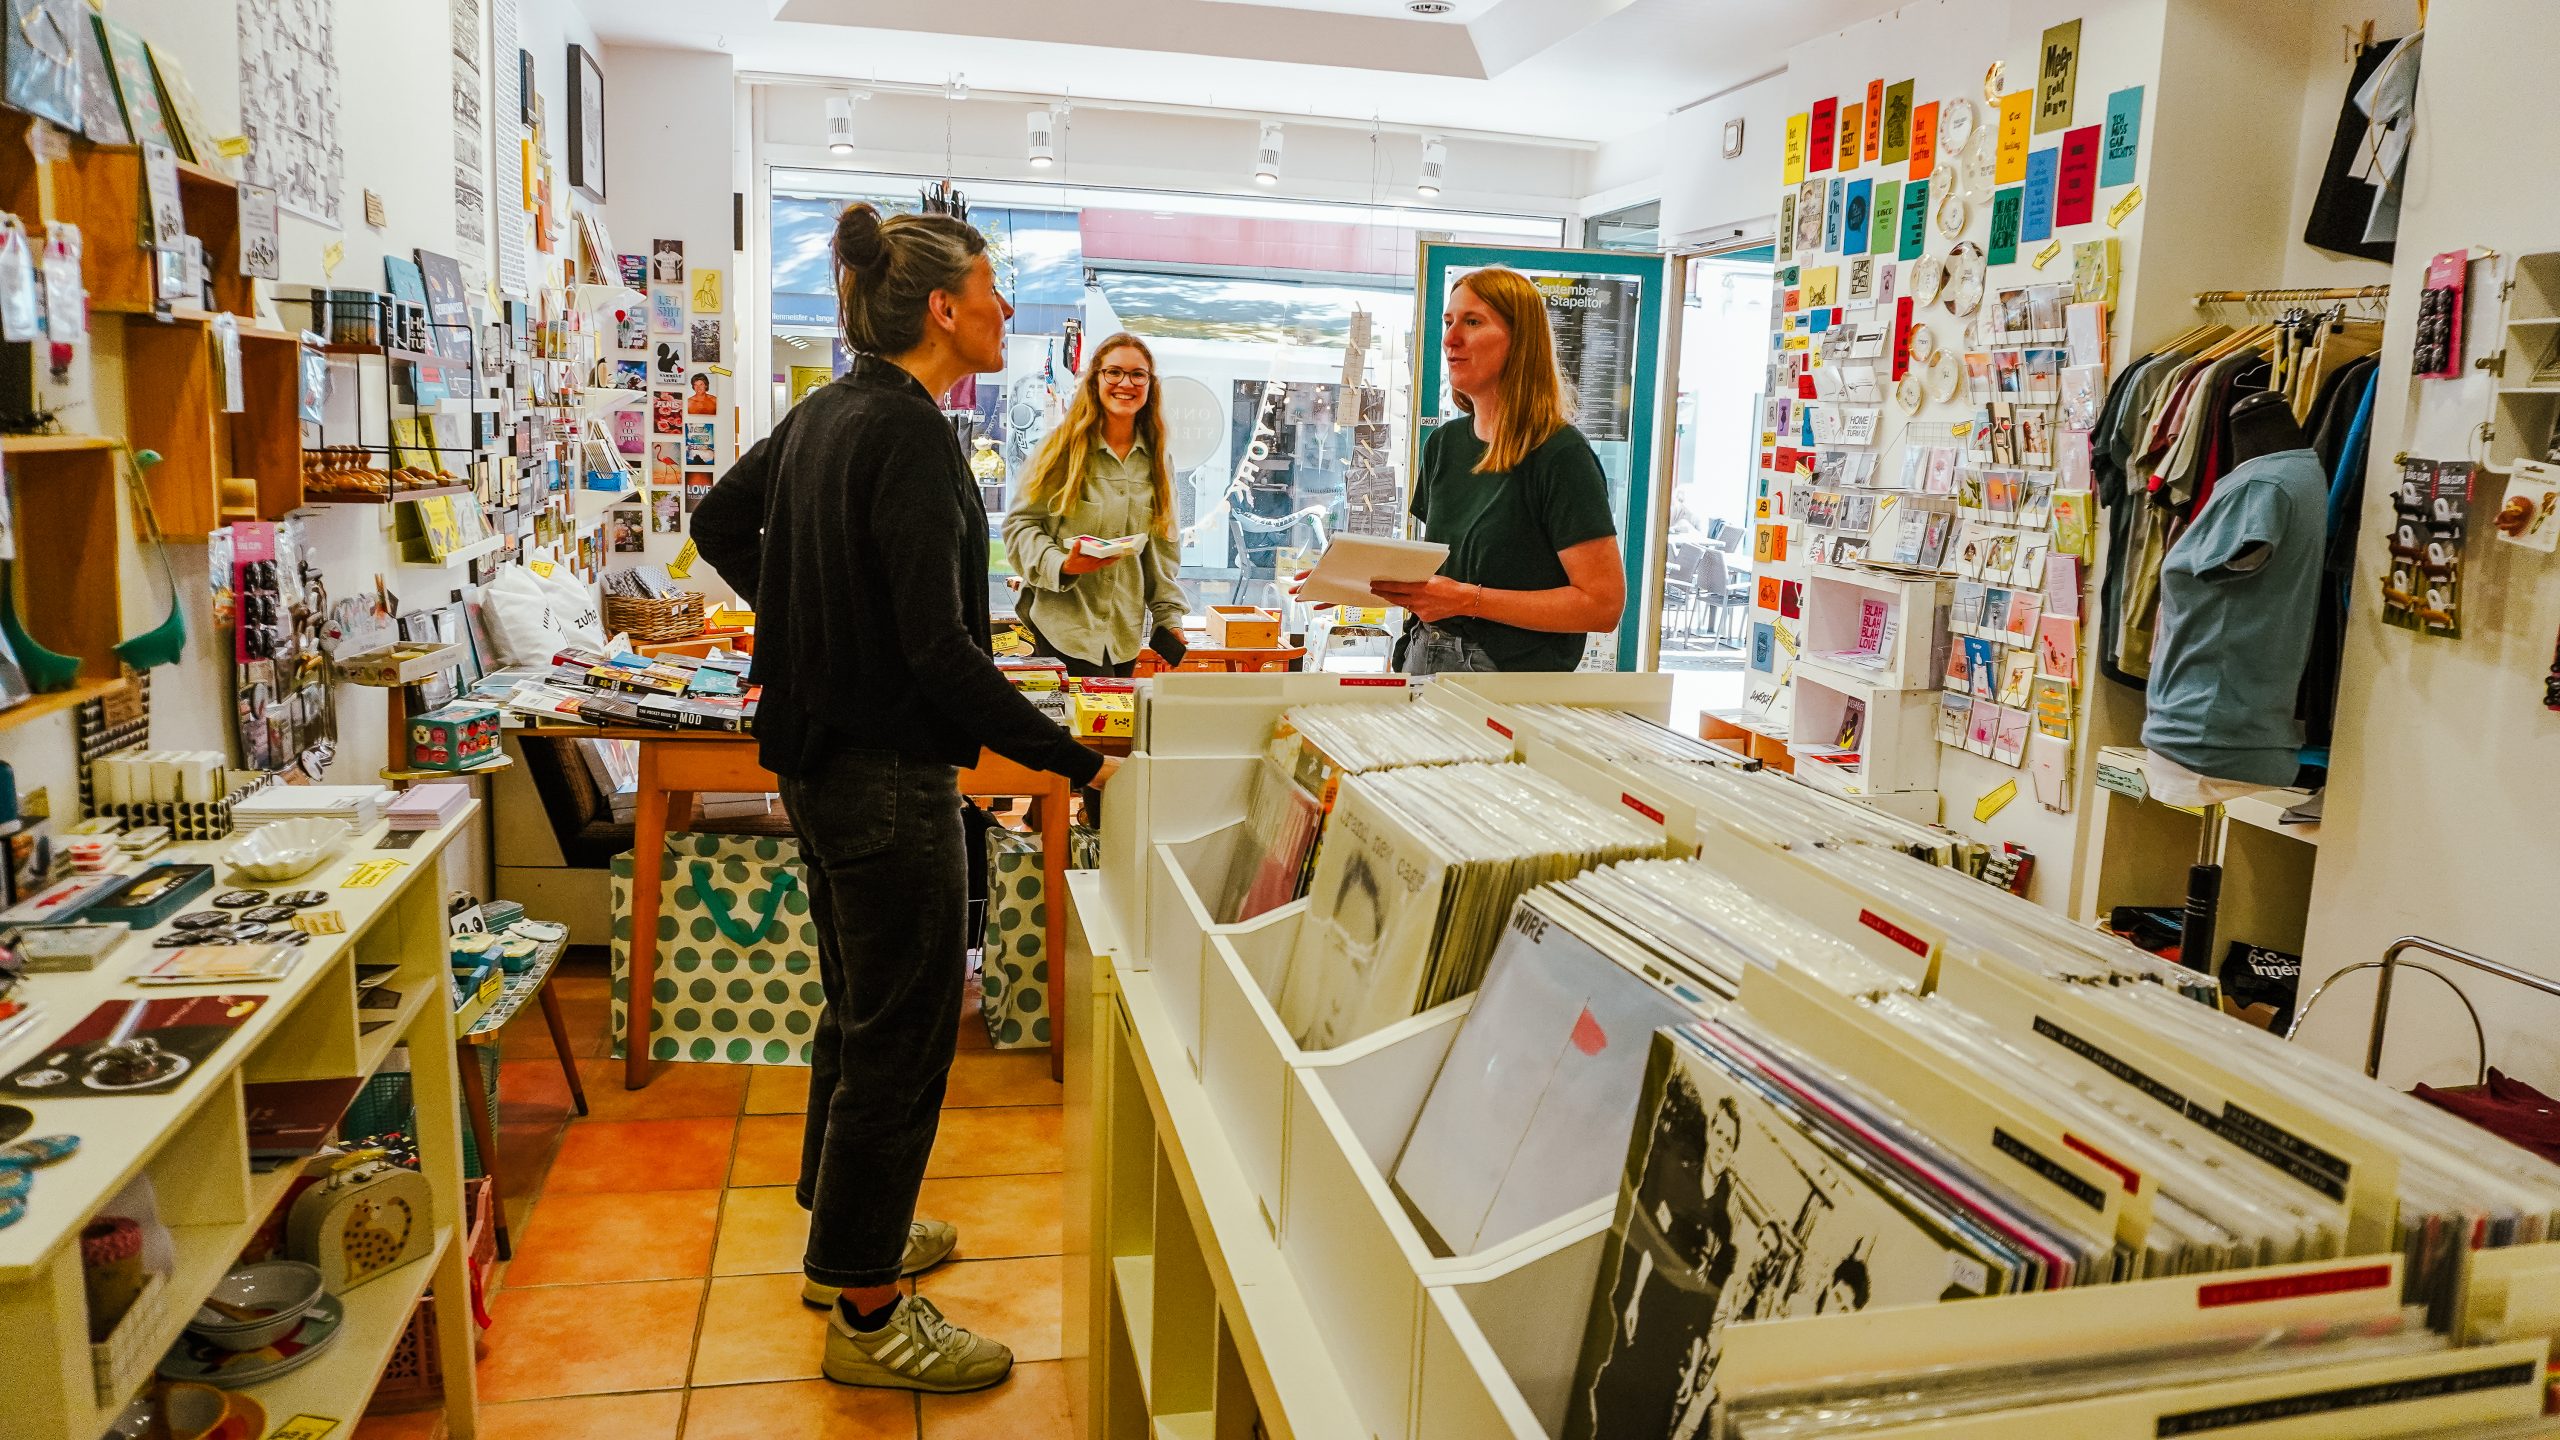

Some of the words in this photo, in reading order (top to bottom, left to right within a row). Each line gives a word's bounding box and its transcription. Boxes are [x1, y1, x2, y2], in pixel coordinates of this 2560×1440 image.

[1533, 282, 1598, 297] September
[1550, 295, 1605, 309] Stapeltor
[1849, 415, 1870, 425] HOME
[687, 485, 711, 495] LOVE
[1864, 604, 1884, 618] BLAH
[1863, 615, 1882, 629] BLAH
[1861, 626, 1880, 640] BLAH
[1859, 637, 1877, 651] LOVE
[680, 712, 702, 726] MOD
[1512, 908, 1549, 945] WIRE
